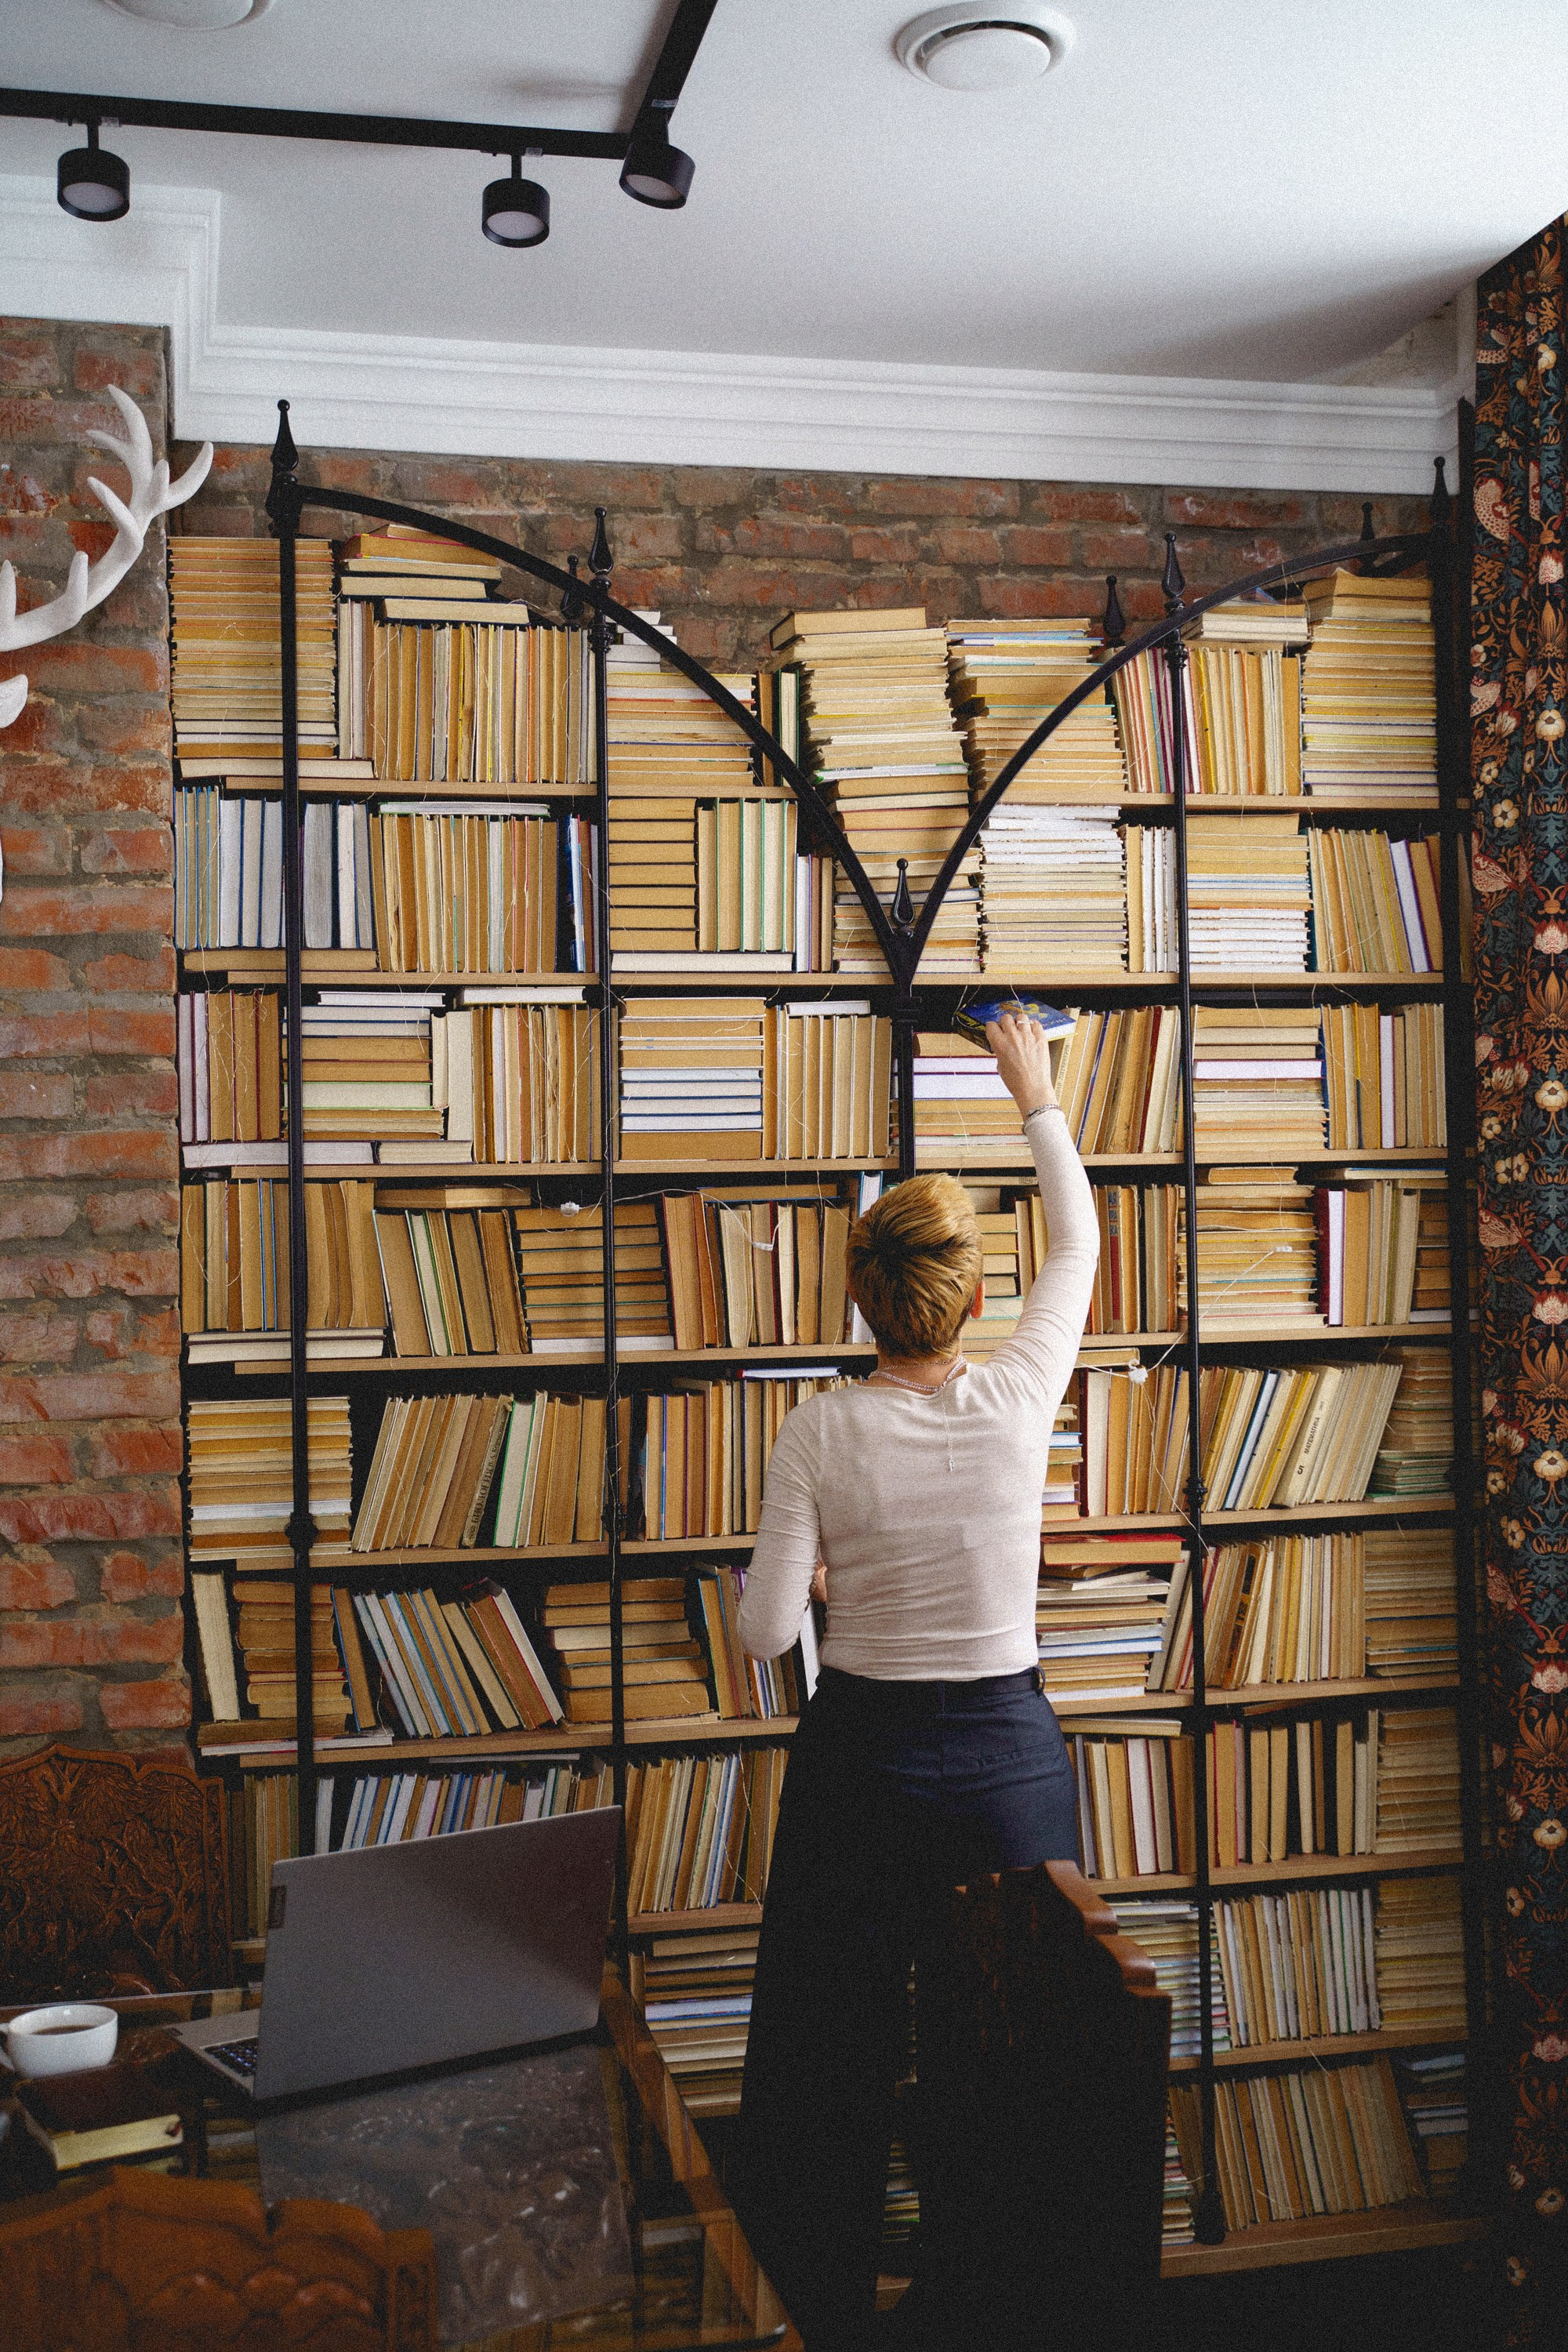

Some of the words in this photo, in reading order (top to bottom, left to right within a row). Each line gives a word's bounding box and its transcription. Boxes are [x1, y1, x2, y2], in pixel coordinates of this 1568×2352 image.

[1304, 1417, 1319, 1454] МАТЕМАТИКА
[1297, 1465, 1305, 1475] 5
[471, 1467, 493, 1523] БИОЛОГИЯ
